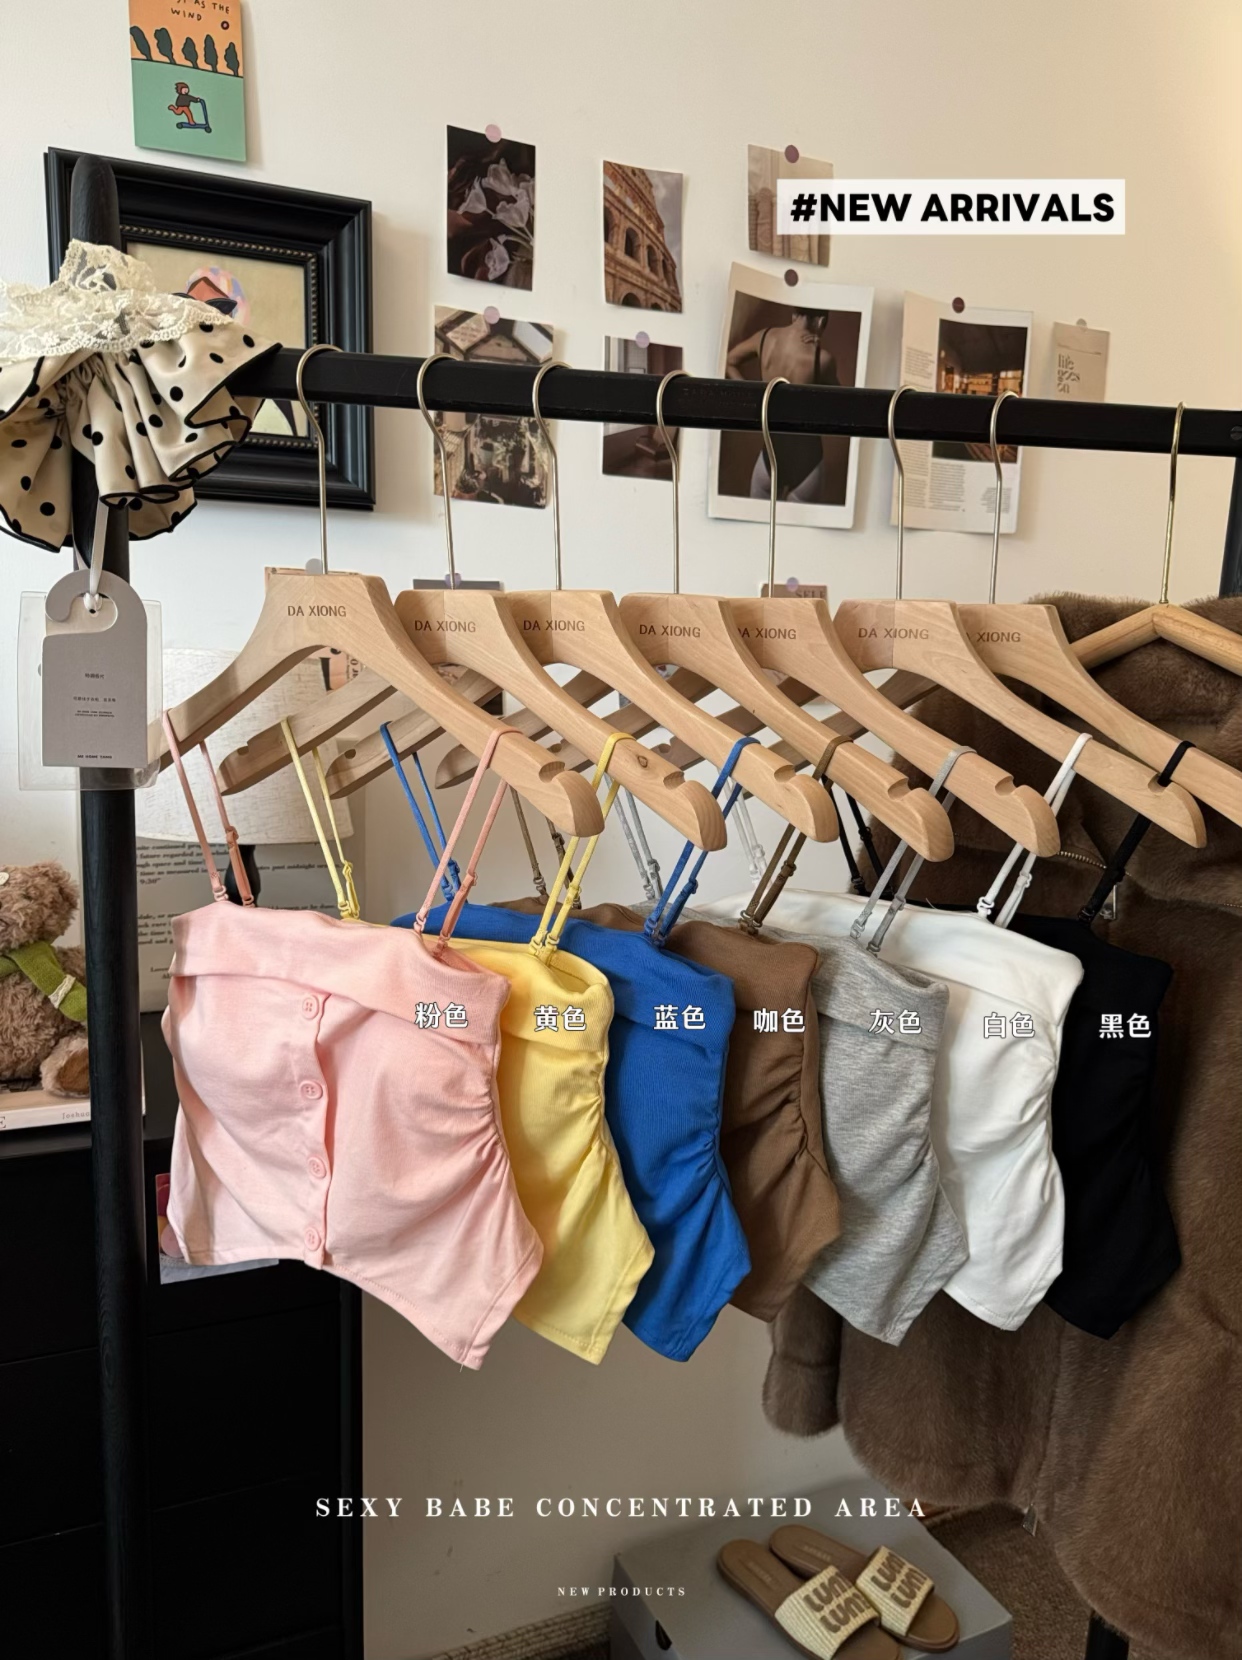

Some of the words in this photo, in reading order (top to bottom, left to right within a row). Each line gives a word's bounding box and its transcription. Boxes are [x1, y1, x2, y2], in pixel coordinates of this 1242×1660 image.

[171, 7, 202, 21] WIND
[211, 2, 230, 14] THE
[287, 605, 305, 617] DA
[308, 605, 347, 617] XIONG
[414, 620, 432, 632] DA
[436, 620, 477, 633] XIONG
[523, 619, 540, 632] DA
[546, 619, 586, 632] XIONG
[638, 624, 657, 636] DA
[661, 625, 701, 638] XIONG
[755, 627, 797, 640] XIONG
[857, 627, 878, 639] DA
[883, 627, 930, 640] XIONG
[976, 631, 1022, 643] XIONG
